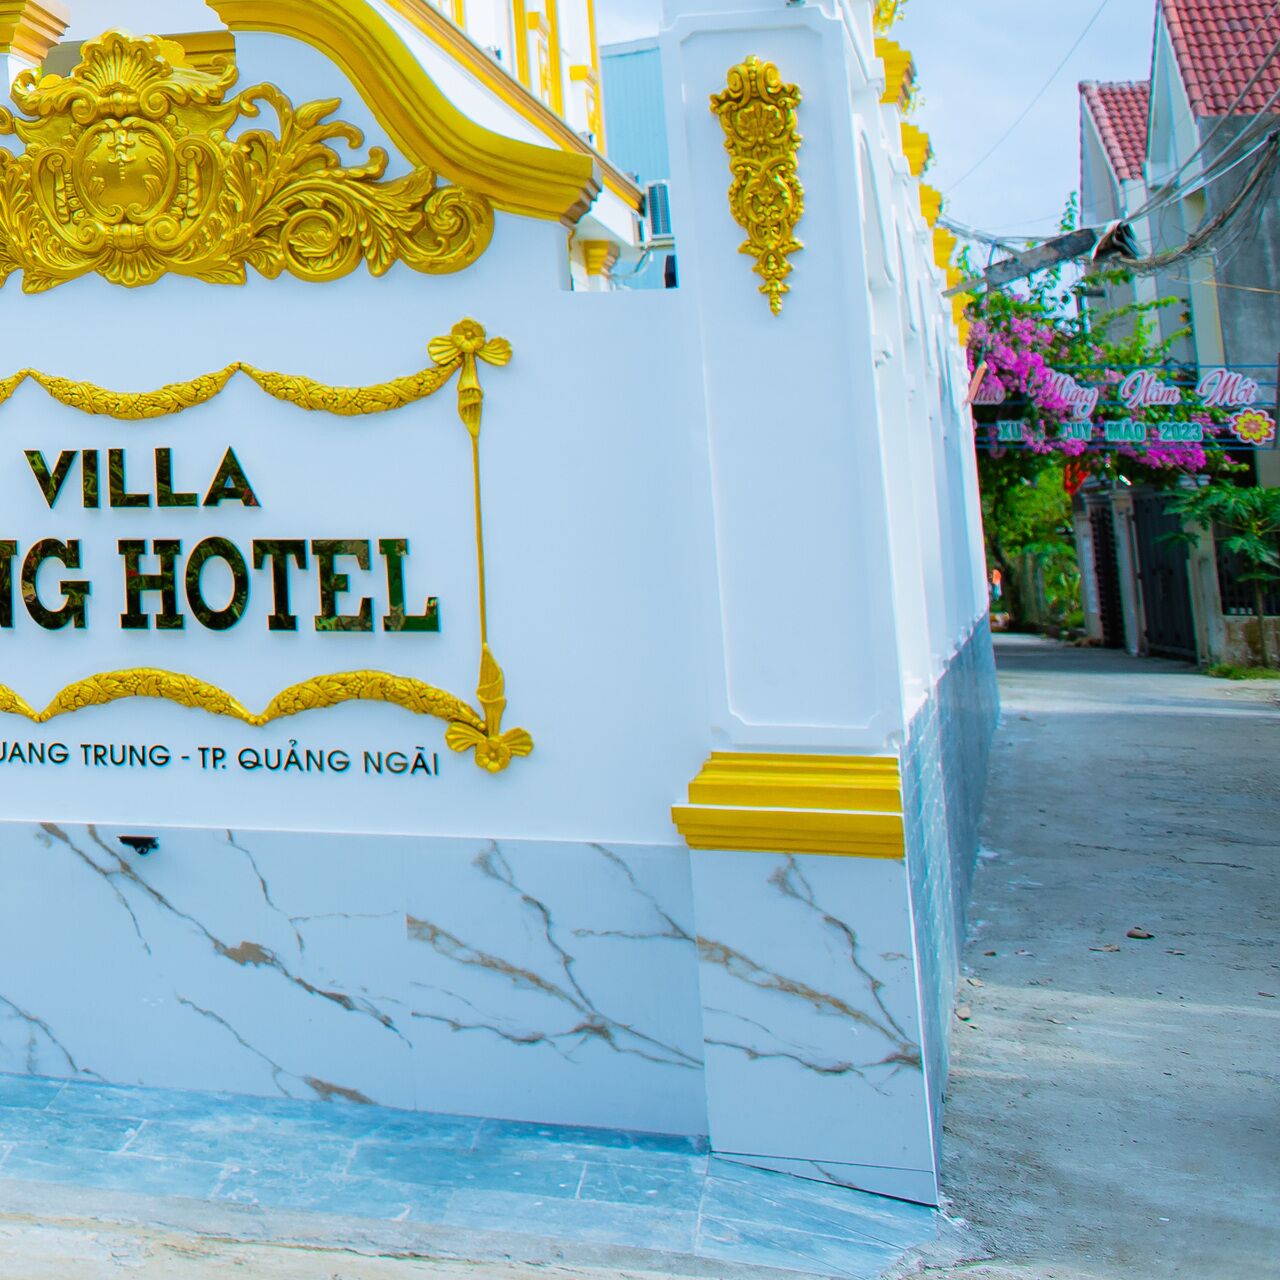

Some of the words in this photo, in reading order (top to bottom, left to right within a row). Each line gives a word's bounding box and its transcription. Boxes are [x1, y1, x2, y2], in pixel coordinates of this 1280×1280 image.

[1160, 422, 1203, 441] 2023
[23, 445, 263, 510] VILLA
[117, 535, 442, 634] HOTEL
[80, 742, 172, 767] TRUNG
[198, 747, 227, 770] TP.
[238, 739, 351, 773] QUẢNG
[363, 746, 440, 777] NGÃI
